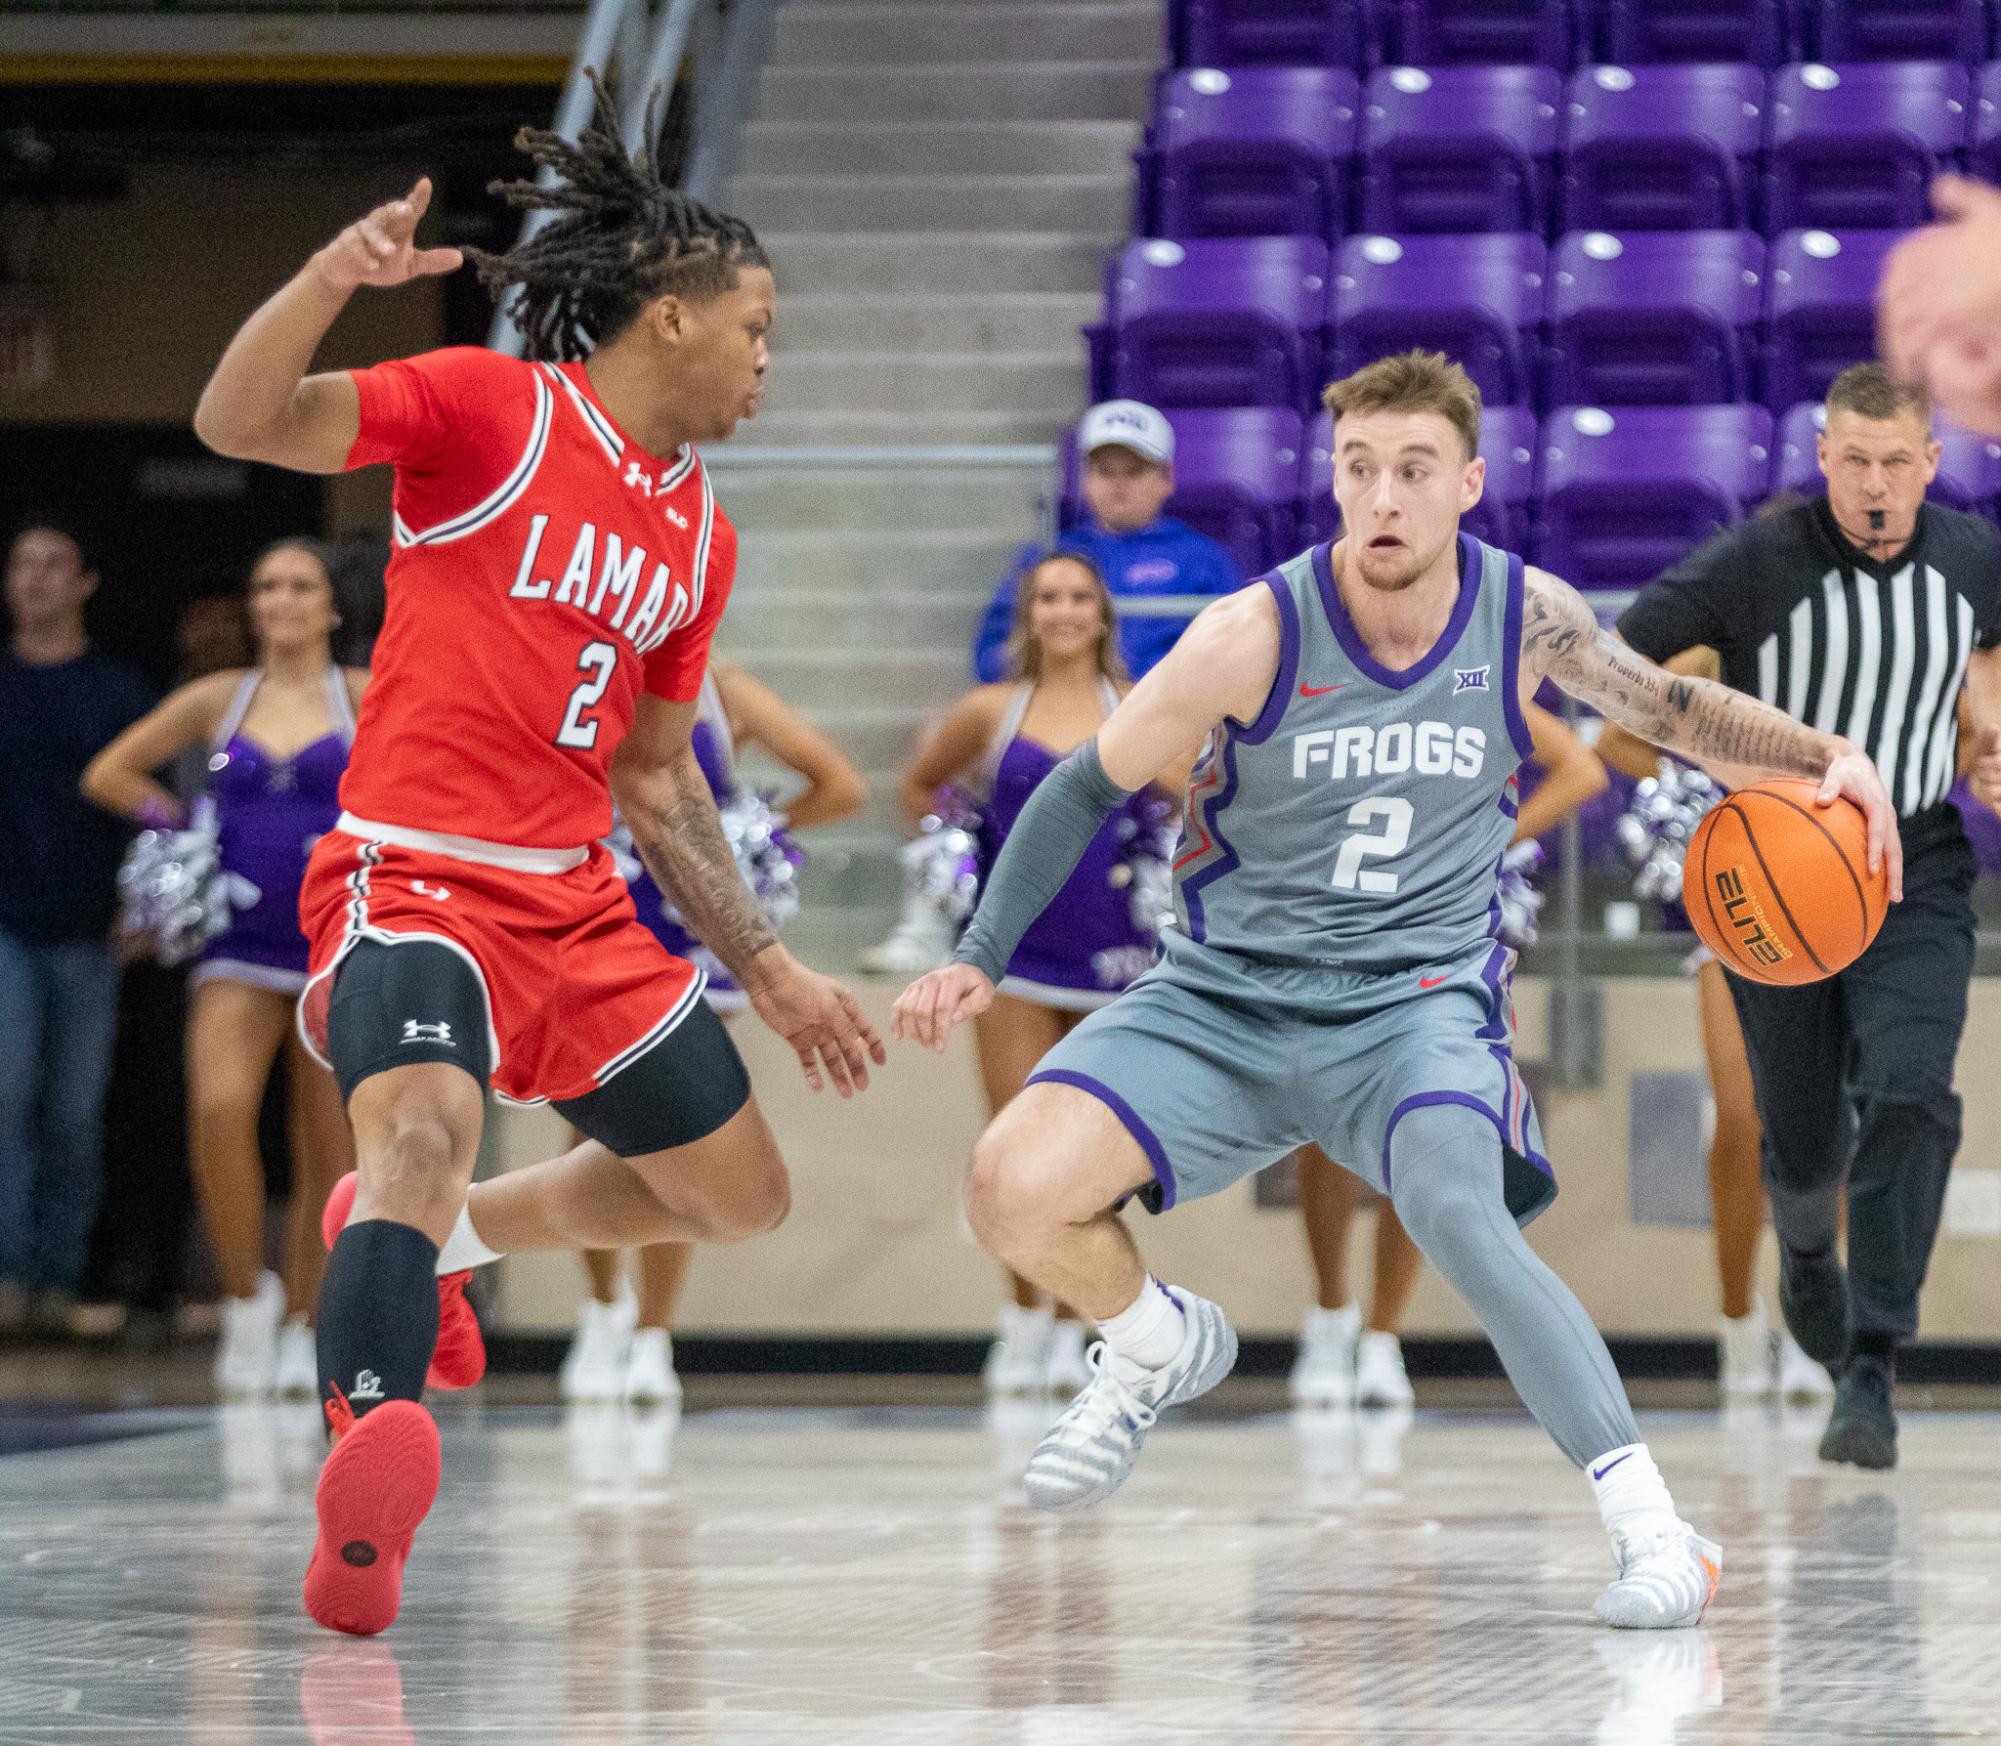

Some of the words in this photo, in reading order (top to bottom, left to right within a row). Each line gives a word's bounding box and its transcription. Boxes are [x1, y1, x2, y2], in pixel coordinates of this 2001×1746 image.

[509, 514, 689, 655] LAMAR
[553, 639, 617, 749] 2
[1457, 669, 1488, 691] XII
[1293, 721, 1487, 779] FROGS
[1331, 796, 1415, 893] 2
[1715, 867, 1784, 967] ELITE
